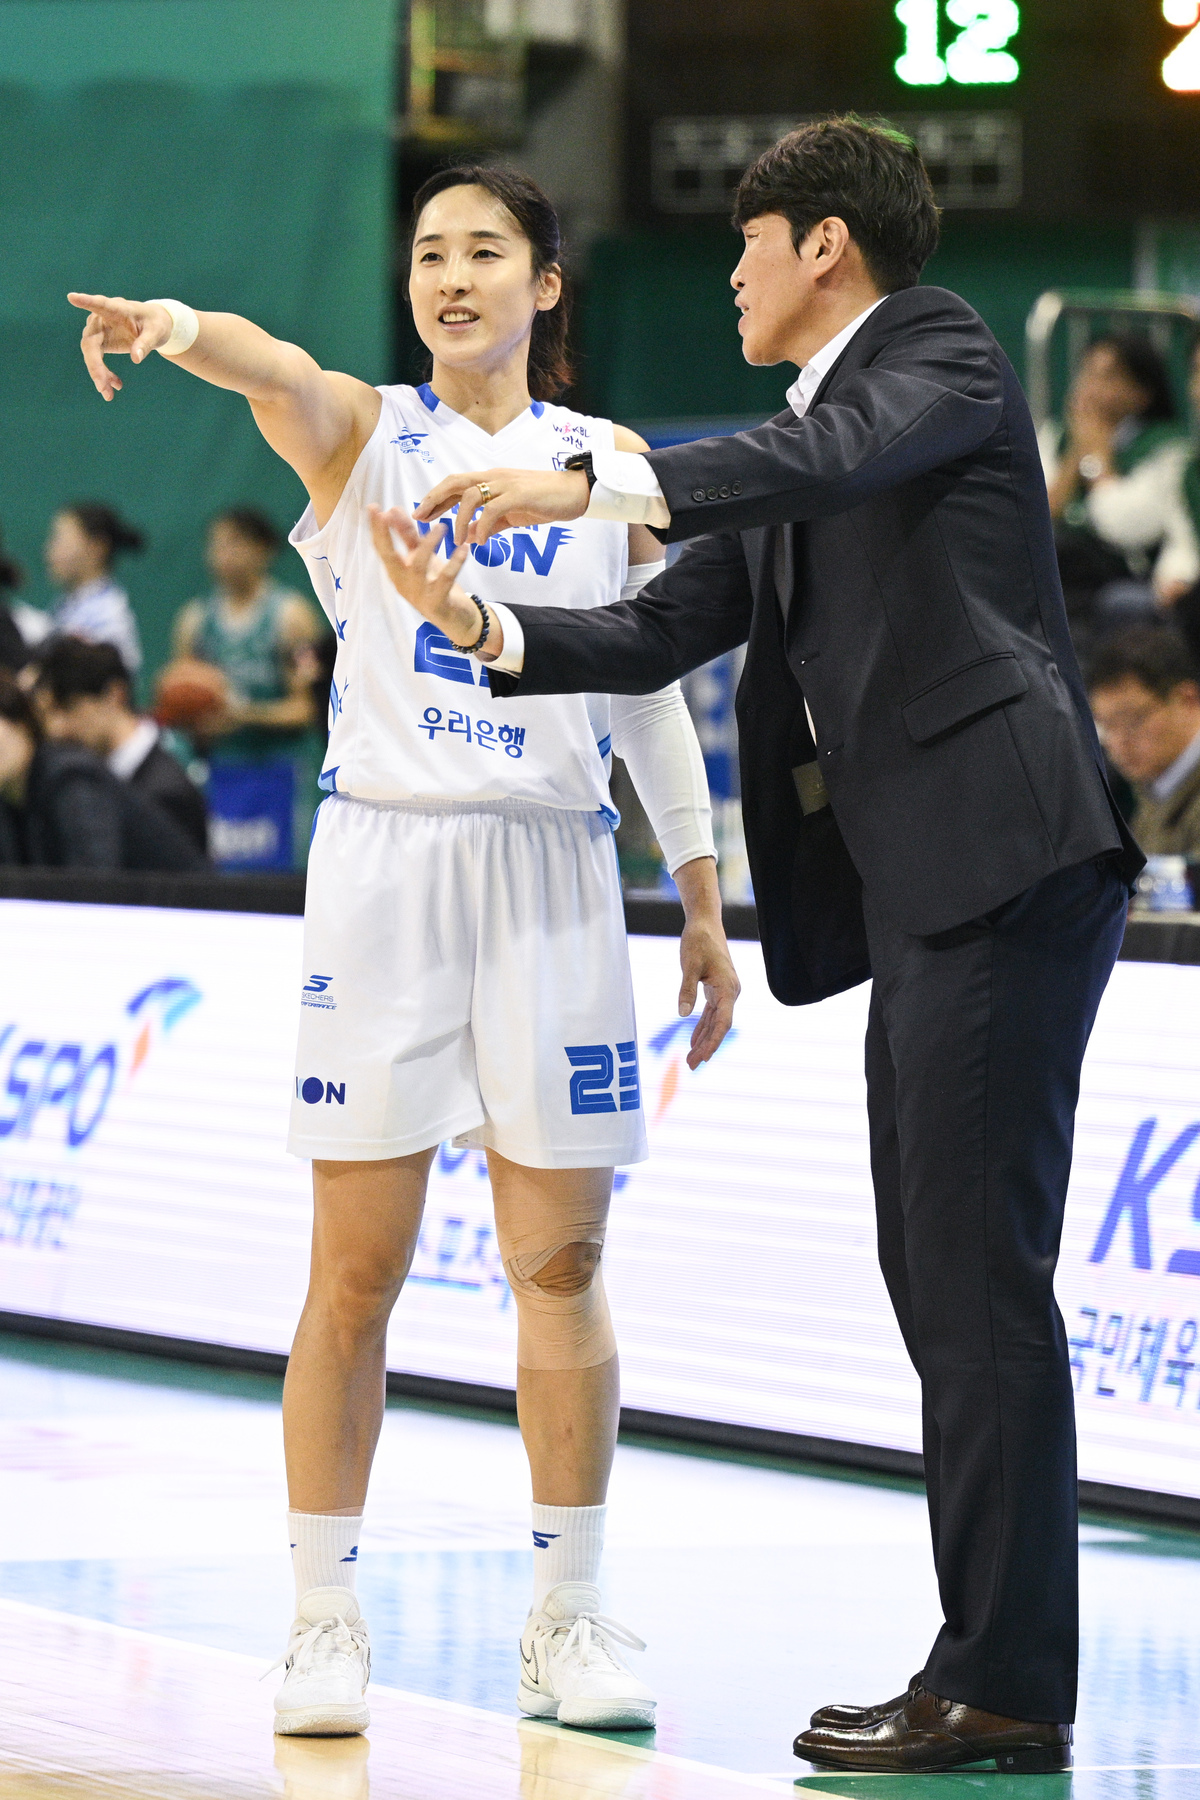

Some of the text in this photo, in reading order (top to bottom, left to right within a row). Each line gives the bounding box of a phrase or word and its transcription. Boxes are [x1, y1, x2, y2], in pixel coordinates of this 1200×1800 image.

[895, 0, 1018, 85] 12
[418, 707, 526, 759] 우리은행
[0, 1024, 118, 1149] SPO
